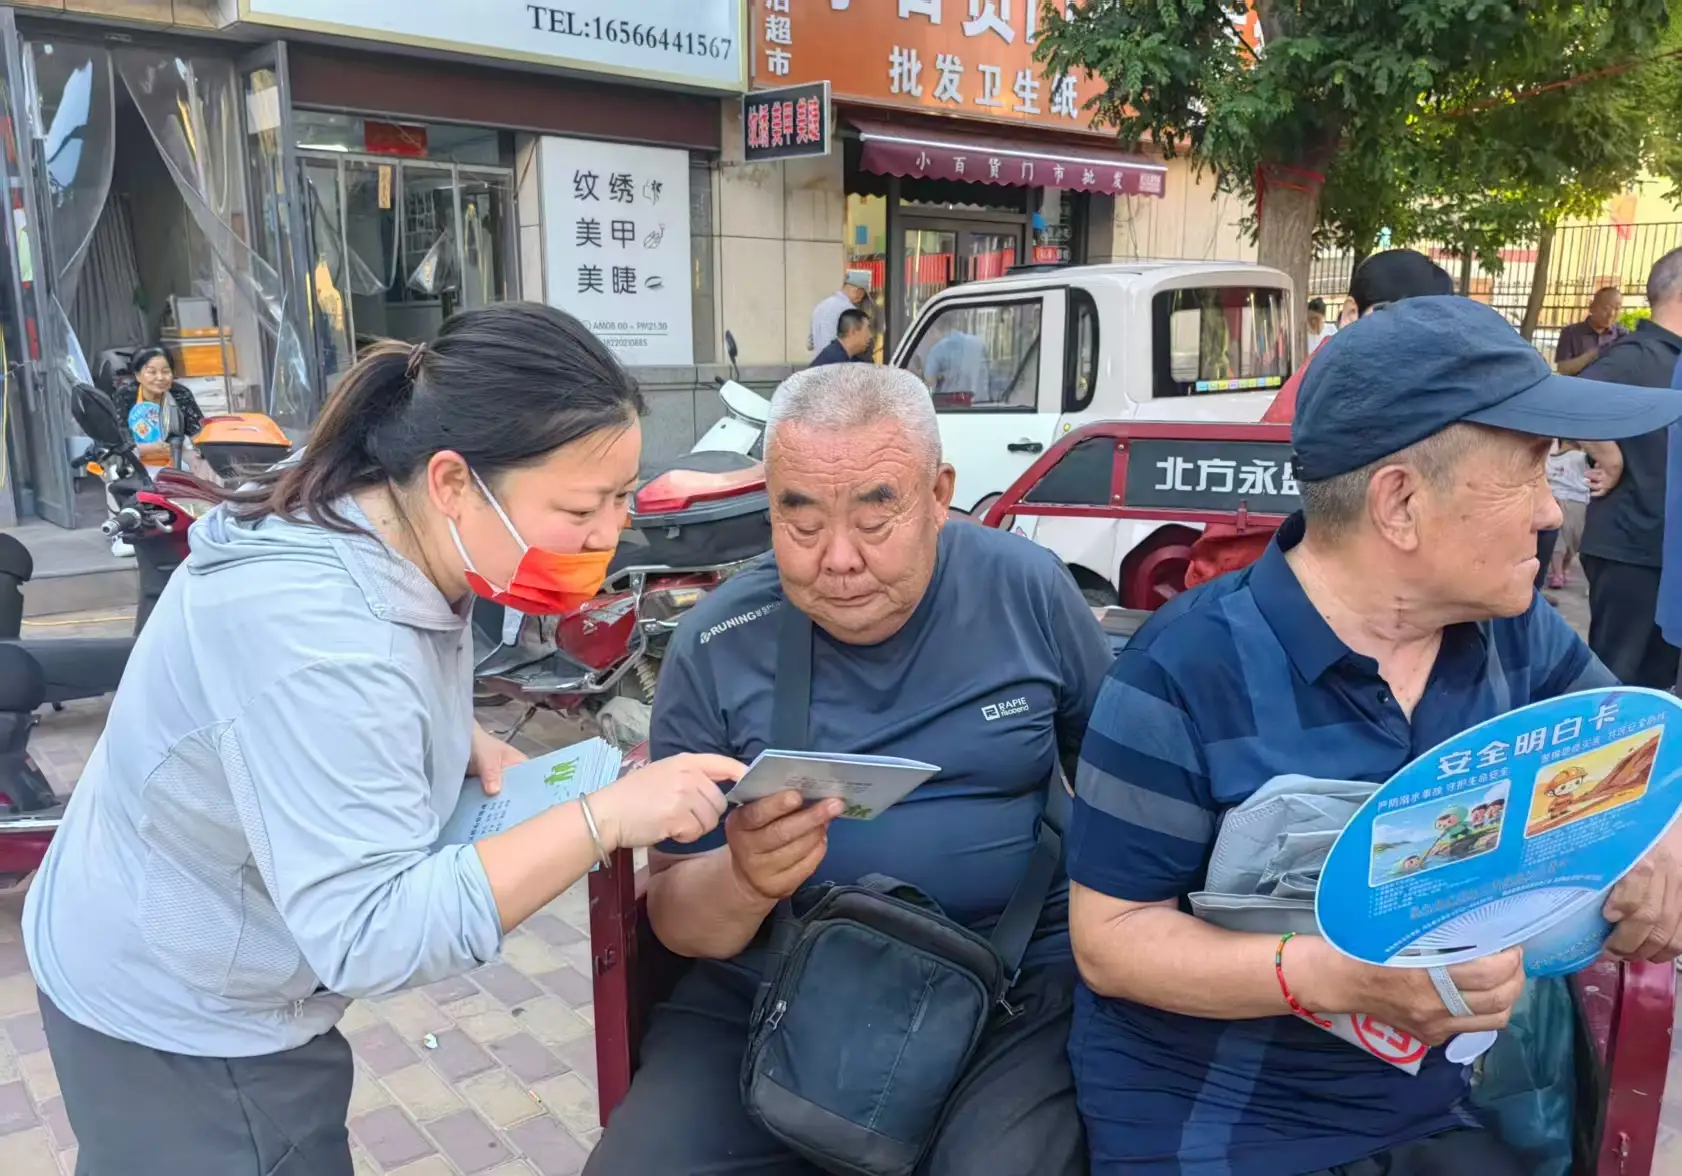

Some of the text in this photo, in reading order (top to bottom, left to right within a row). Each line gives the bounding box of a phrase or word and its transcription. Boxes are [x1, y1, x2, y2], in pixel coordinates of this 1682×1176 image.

[527, 5, 732, 60] TEL:16566441567
[889, 45, 1079, 120] 批发卫生纸
[573, 169, 634, 204] 纹绣
[915, 152, 1124, 189] 小百货门市批发
[576, 217, 636, 249] 美甲
[577, 264, 637, 295] 美睫
[709, 611, 757, 636] RUNING
[1437, 703, 1619, 780] 安全明白卡
[1446, 767, 1509, 792] 守护生命安全
